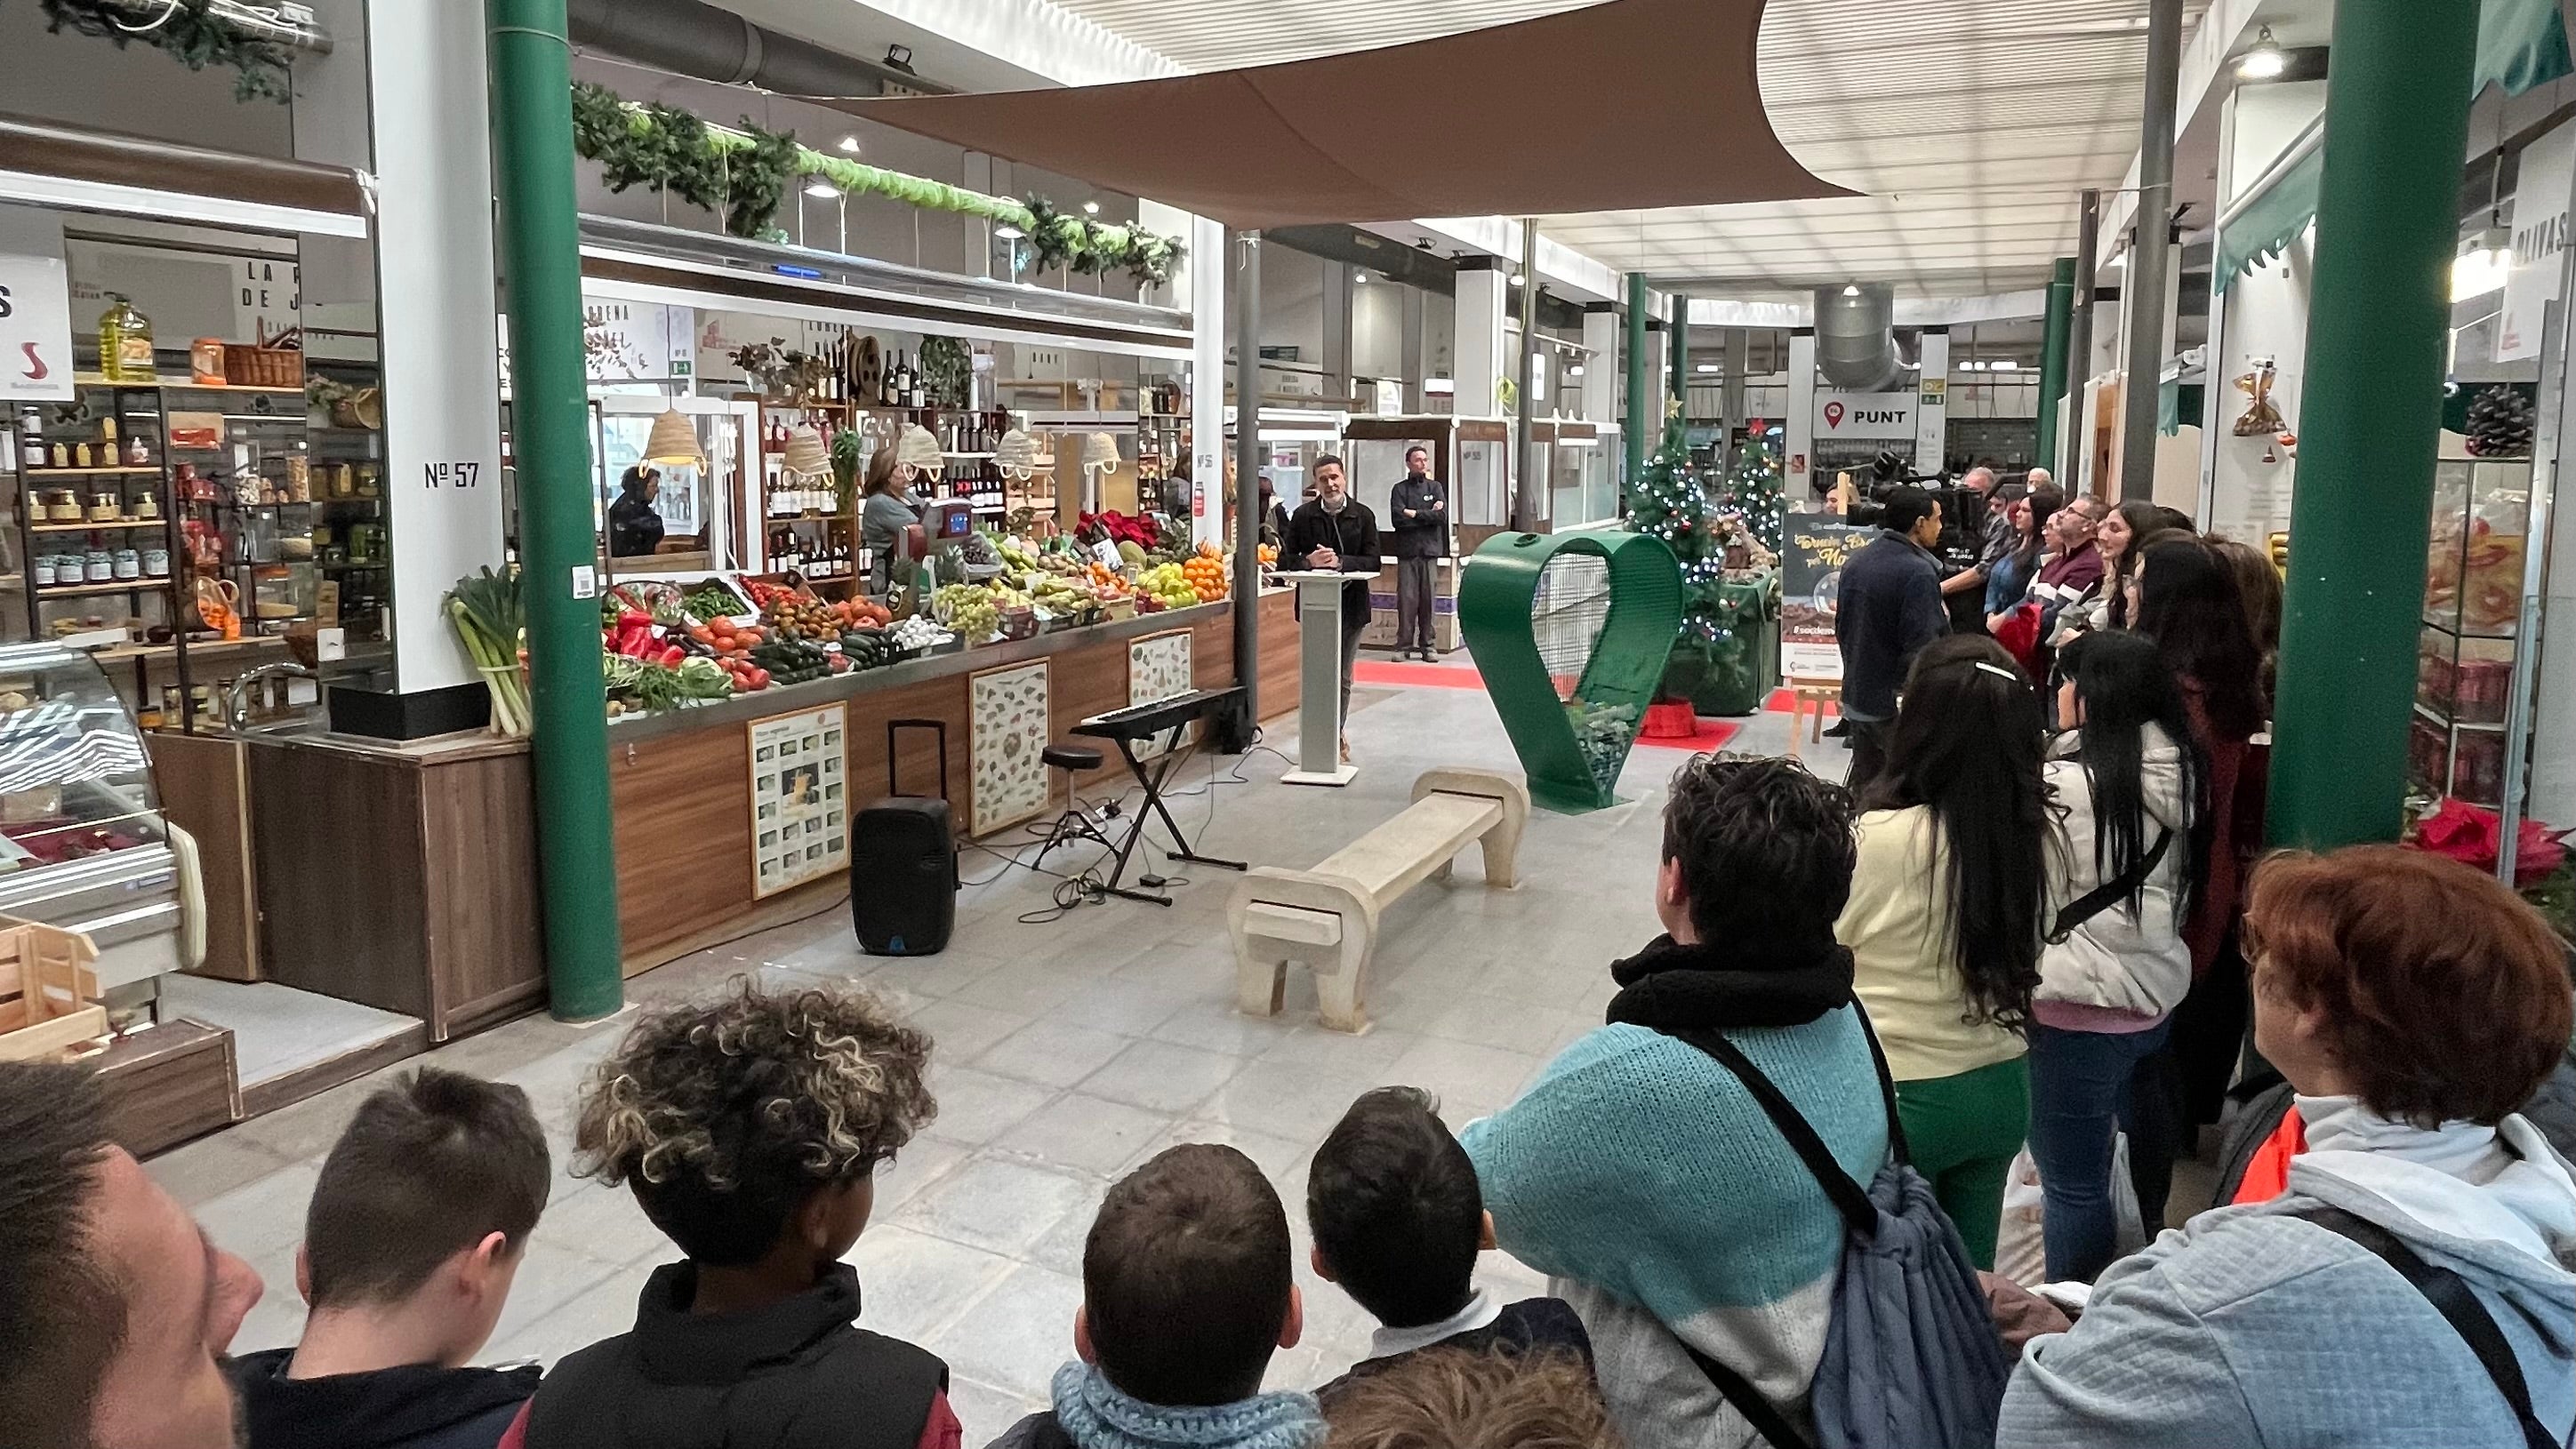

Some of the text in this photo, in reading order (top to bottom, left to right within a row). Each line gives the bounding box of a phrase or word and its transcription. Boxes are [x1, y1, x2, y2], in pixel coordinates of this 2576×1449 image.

[247, 260, 272, 282] LA
[242, 287, 269, 308] DE
[1854, 411, 1906, 423] PUNT
[454, 462, 478, 488] 57
